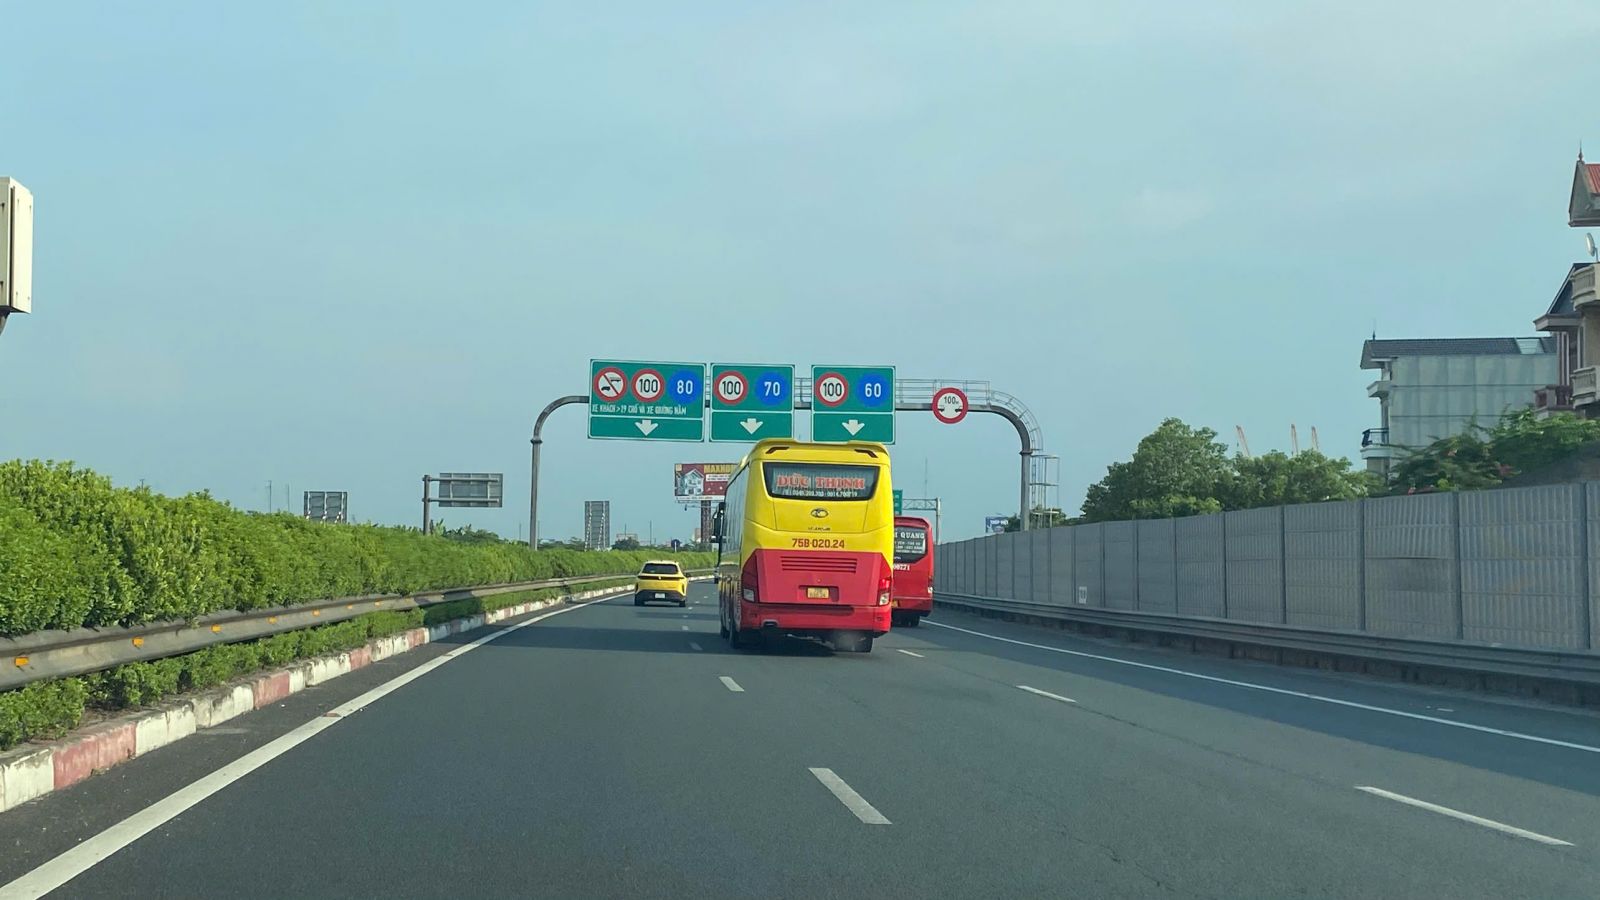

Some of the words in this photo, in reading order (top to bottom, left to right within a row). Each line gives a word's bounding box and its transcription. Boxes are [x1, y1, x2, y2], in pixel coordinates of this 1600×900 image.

[638, 378, 659, 394] 100
[676, 379, 694, 395] 80
[721, 380, 741, 396] 100
[763, 381, 781, 397] 70
[822, 382, 842, 397] 100
[864, 382, 882, 398] 60
[591, 403, 599, 413] XE
[646, 405, 654, 414] XE
